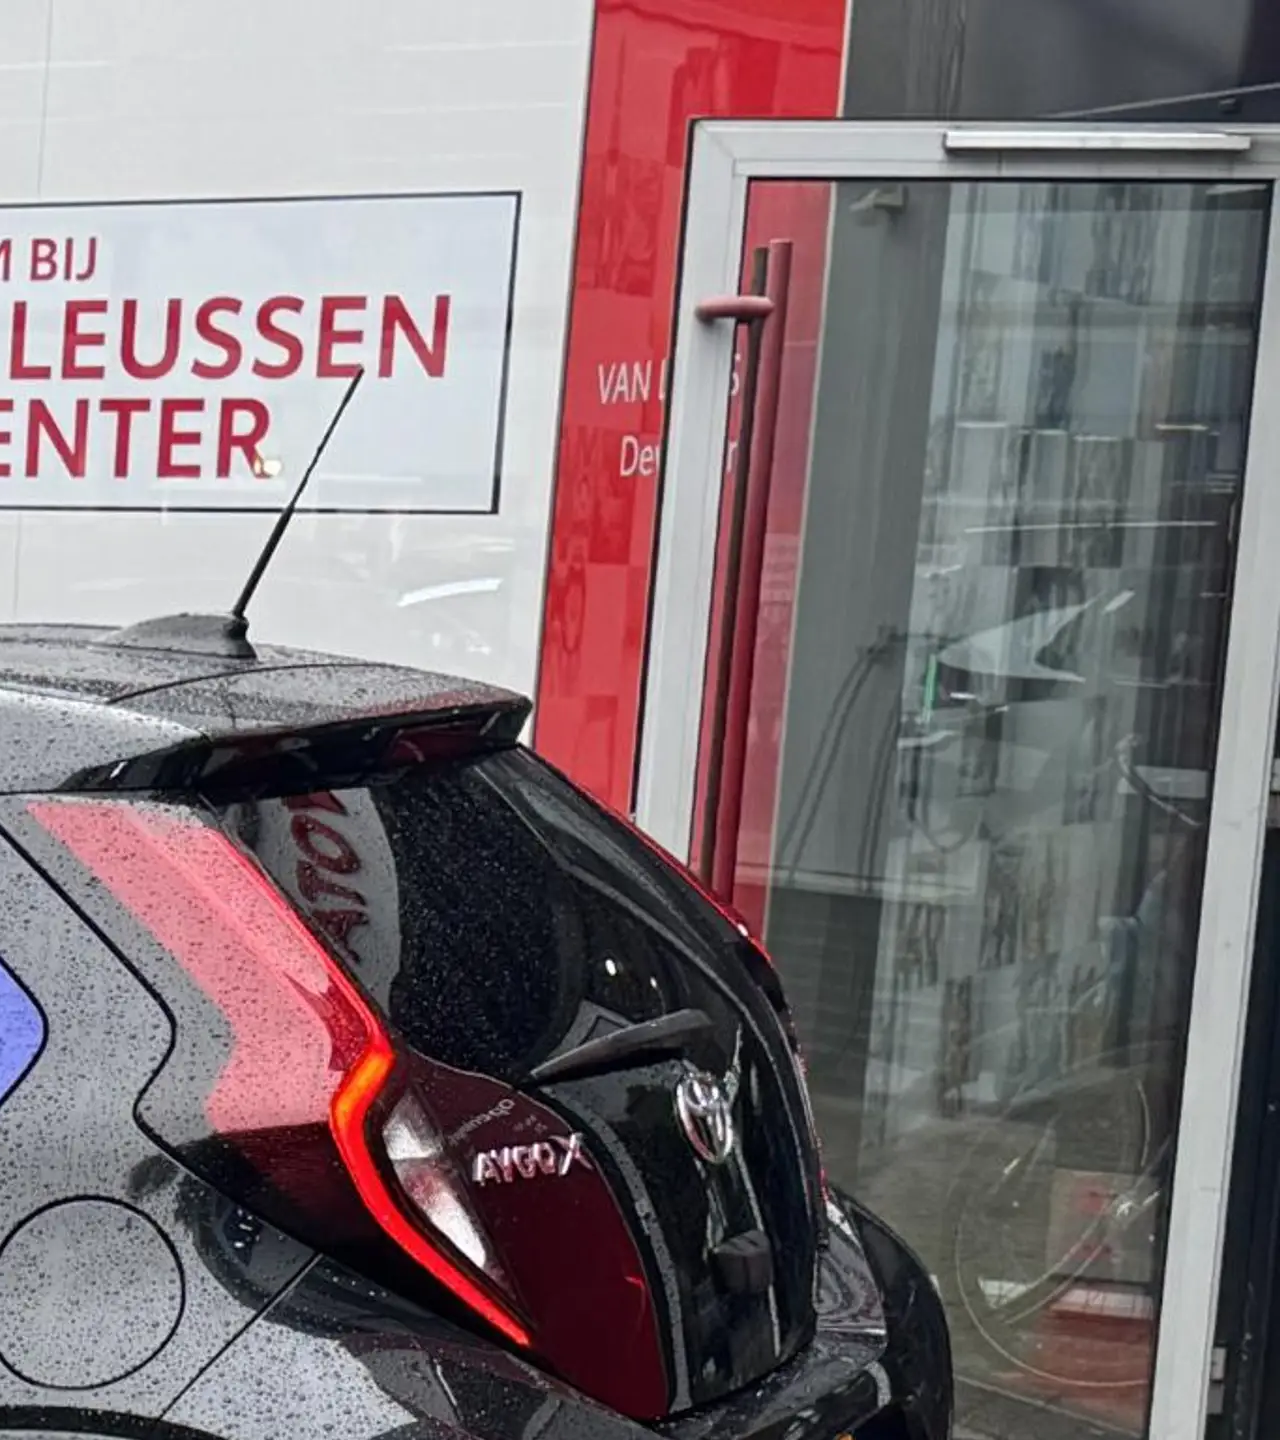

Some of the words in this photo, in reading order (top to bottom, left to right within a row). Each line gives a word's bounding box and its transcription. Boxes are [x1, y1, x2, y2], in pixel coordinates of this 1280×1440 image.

[29, 237, 98, 282] BIJ
[10, 294, 451, 380] LEUSSEN
[598, 359, 653, 404] VAN
